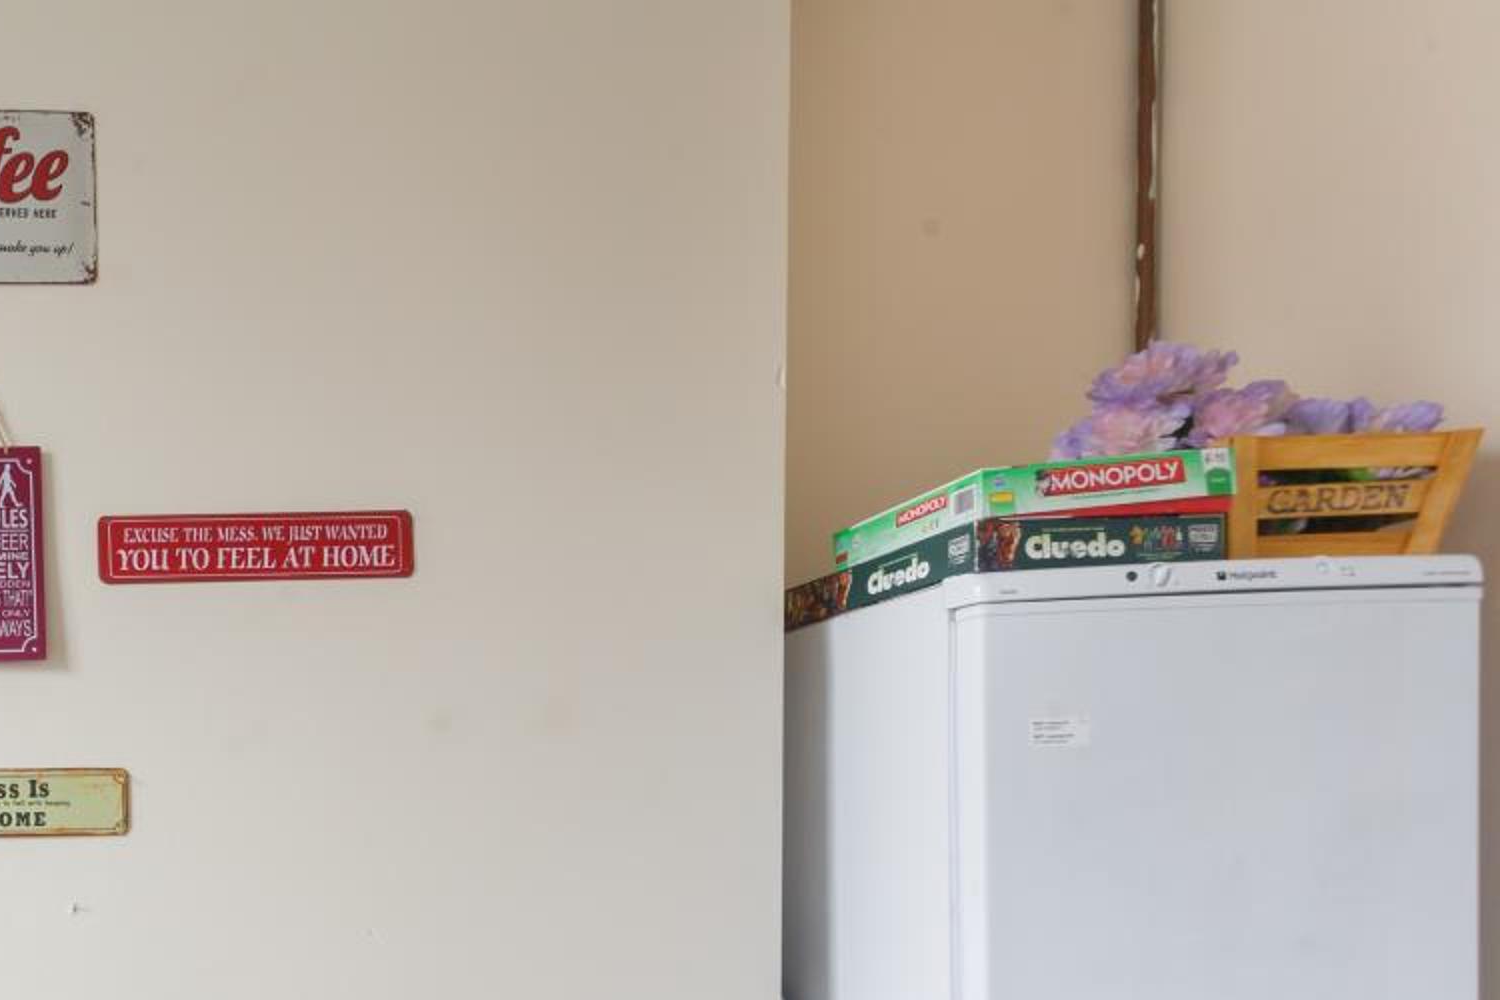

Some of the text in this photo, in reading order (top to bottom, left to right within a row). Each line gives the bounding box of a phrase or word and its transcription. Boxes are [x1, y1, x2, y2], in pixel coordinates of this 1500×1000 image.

[33, 207, 58, 219] HERE
[1050, 460, 1180, 491] MONOPOLY
[897, 495, 949, 526] MONOPOLY
[1266, 483, 1411, 514] GARDEN
[123, 526, 179, 544] EXCUSE
[183, 526, 213, 543] THE
[261, 525, 285, 542] WE
[288, 525, 323, 544] JUST
[324, 523, 388, 541] WANTED
[1025, 531, 1126, 560] Cluedo
[116, 544, 395, 571] YOU TO FEEL AT HOME
[866, 554, 931, 595] Cluedo
[28, 778, 50, 799] IS
